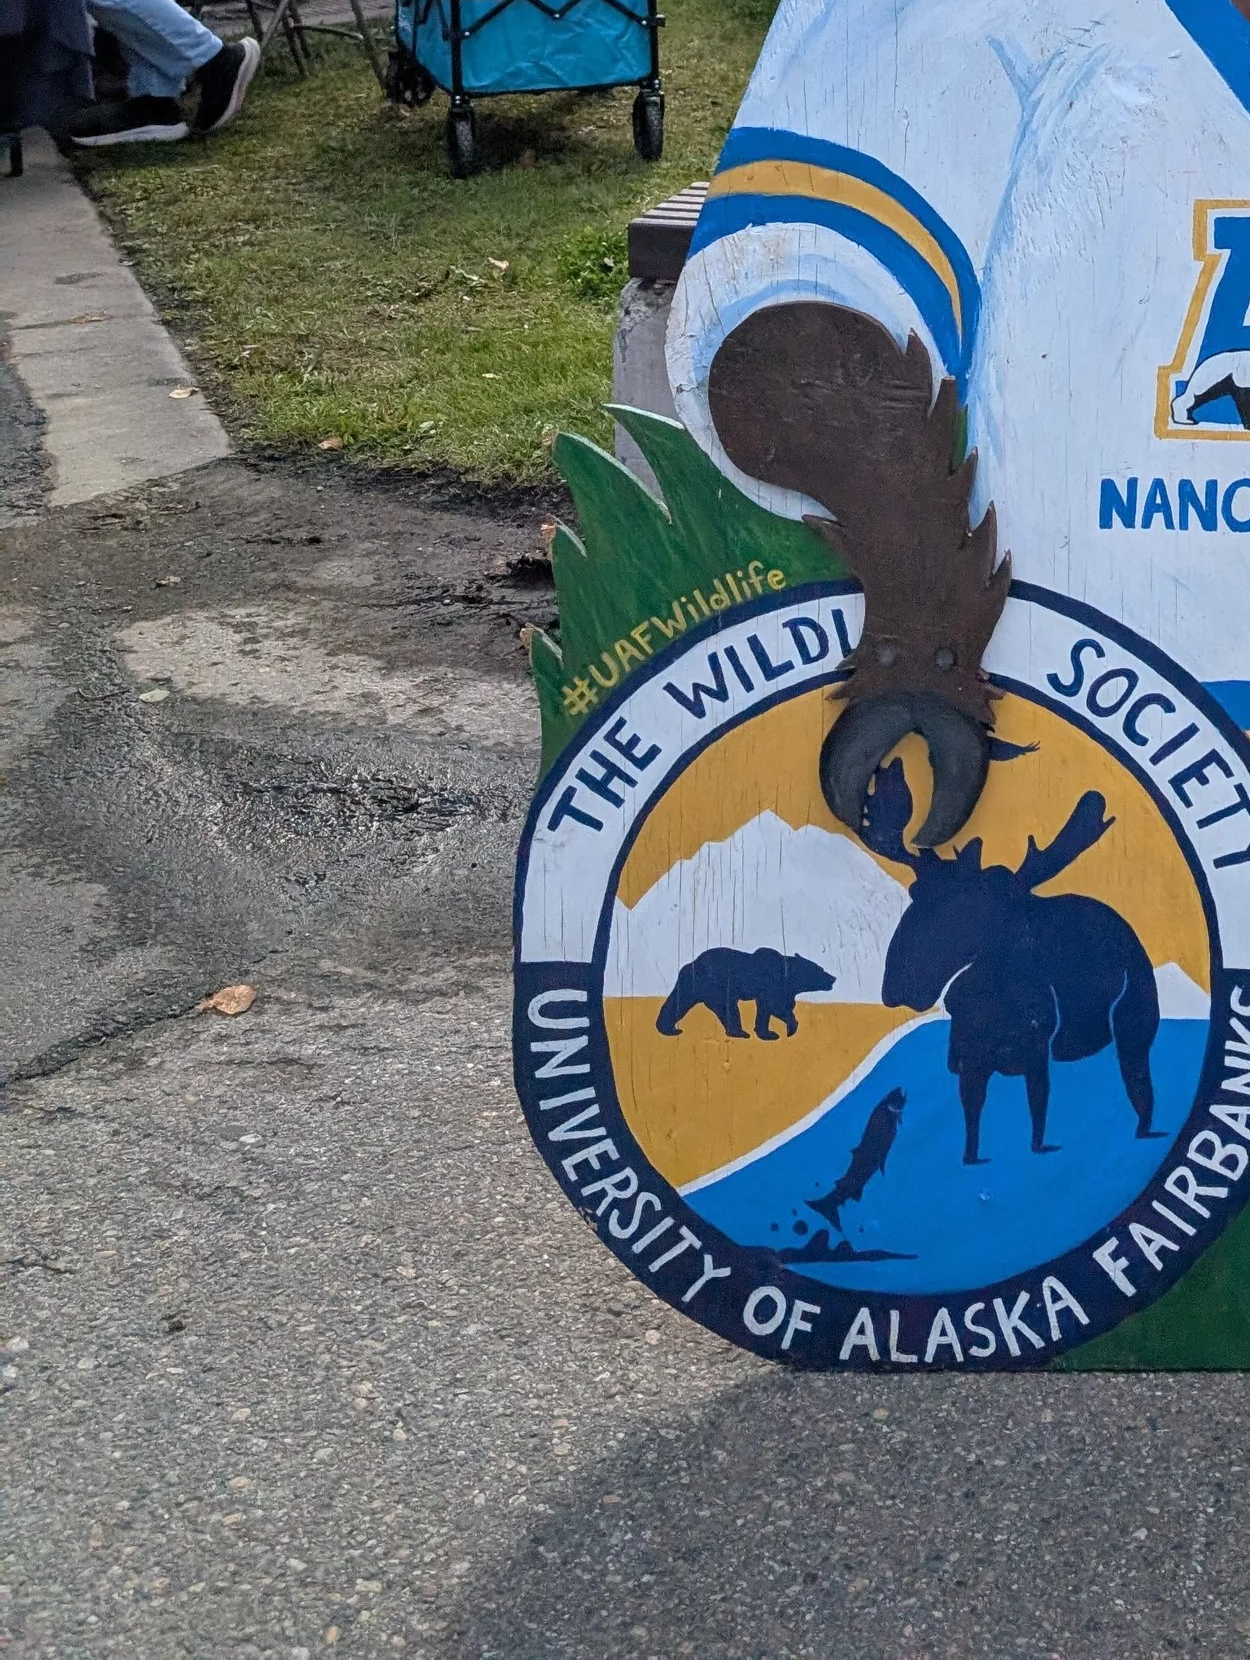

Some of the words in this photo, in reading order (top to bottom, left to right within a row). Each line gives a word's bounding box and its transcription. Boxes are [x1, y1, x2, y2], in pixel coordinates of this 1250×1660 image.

[546, 715, 663, 833] THE
[662, 607, 860, 720] WILDL
[562, 560, 787, 716] #UAFWildlife
[526, 988, 732, 1303] UNIVERSITY
[742, 1285, 821, 1350] OF
[838, 1274, 1091, 1363] ALASKA
